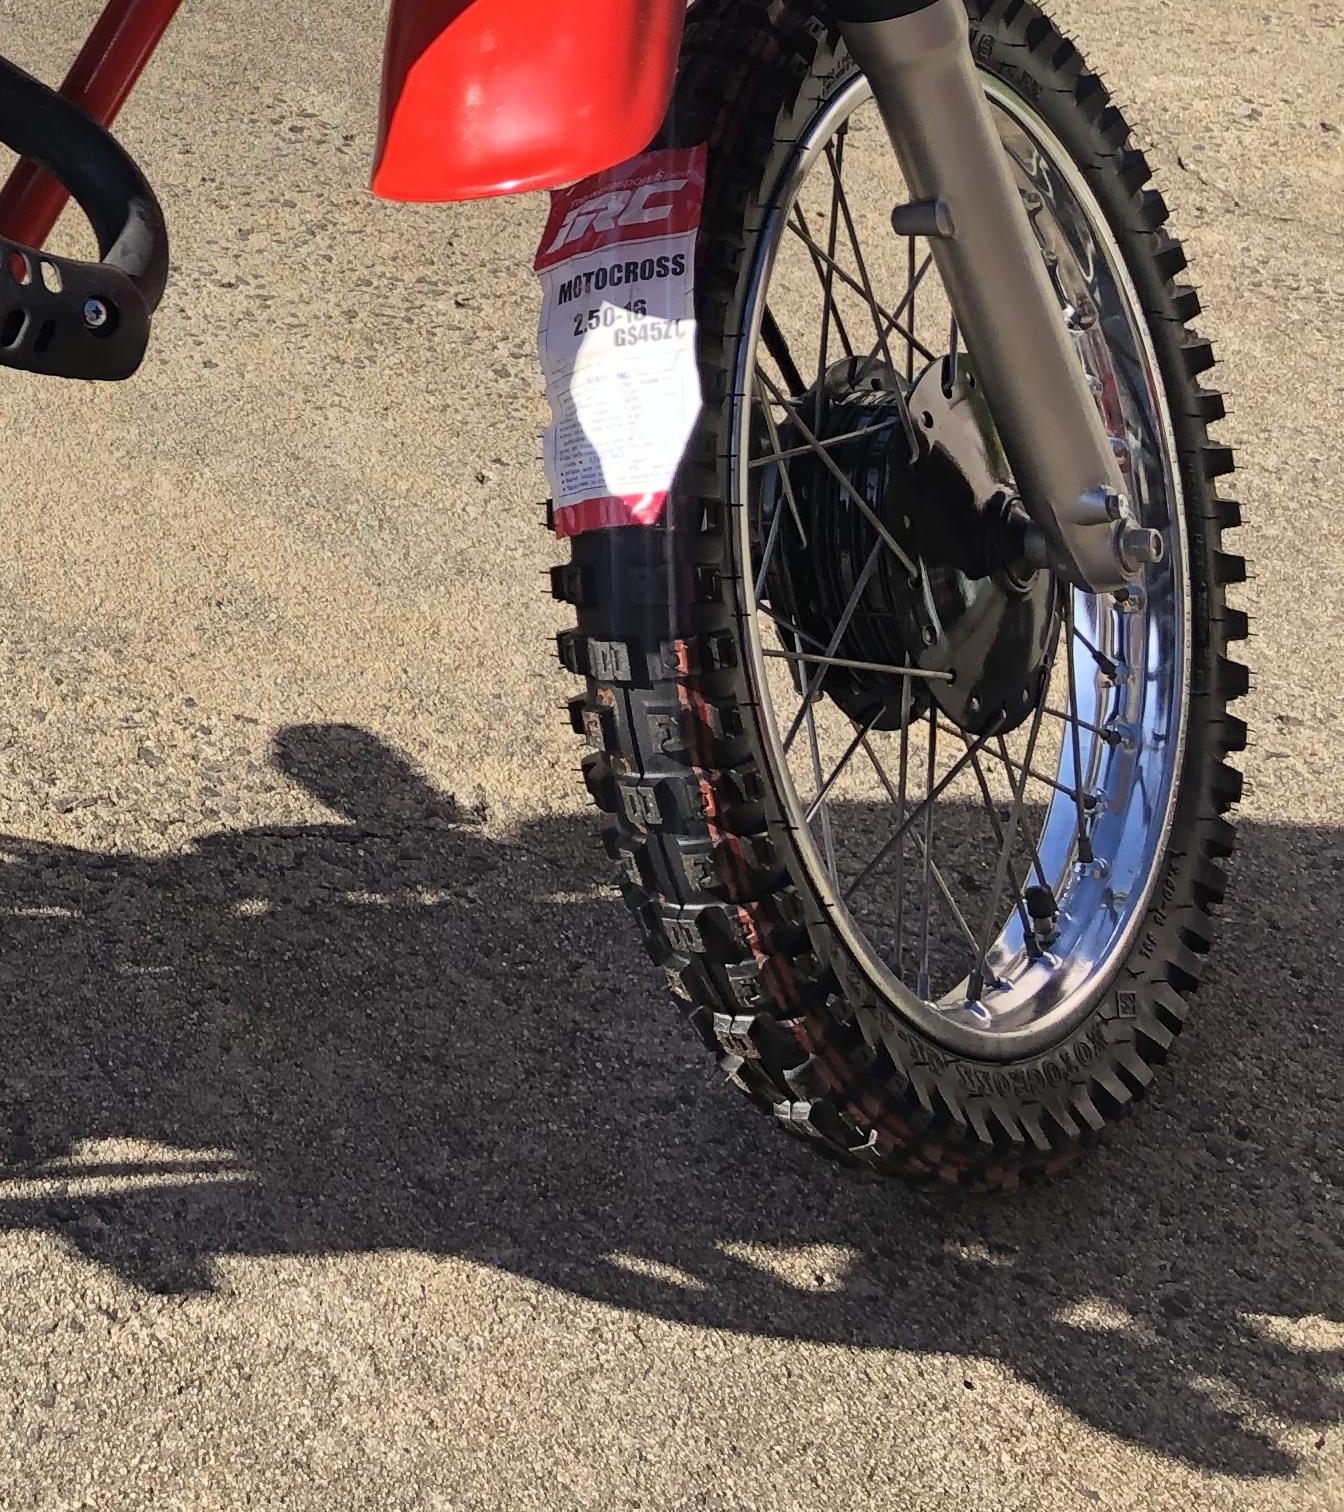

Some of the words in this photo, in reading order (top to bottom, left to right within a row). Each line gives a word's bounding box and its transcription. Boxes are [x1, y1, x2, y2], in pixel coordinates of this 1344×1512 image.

[546, 179, 688, 254] IRC
[558, 254, 686, 306] MOTOCROSS
[573, 299, 647, 337] 2.50-16
